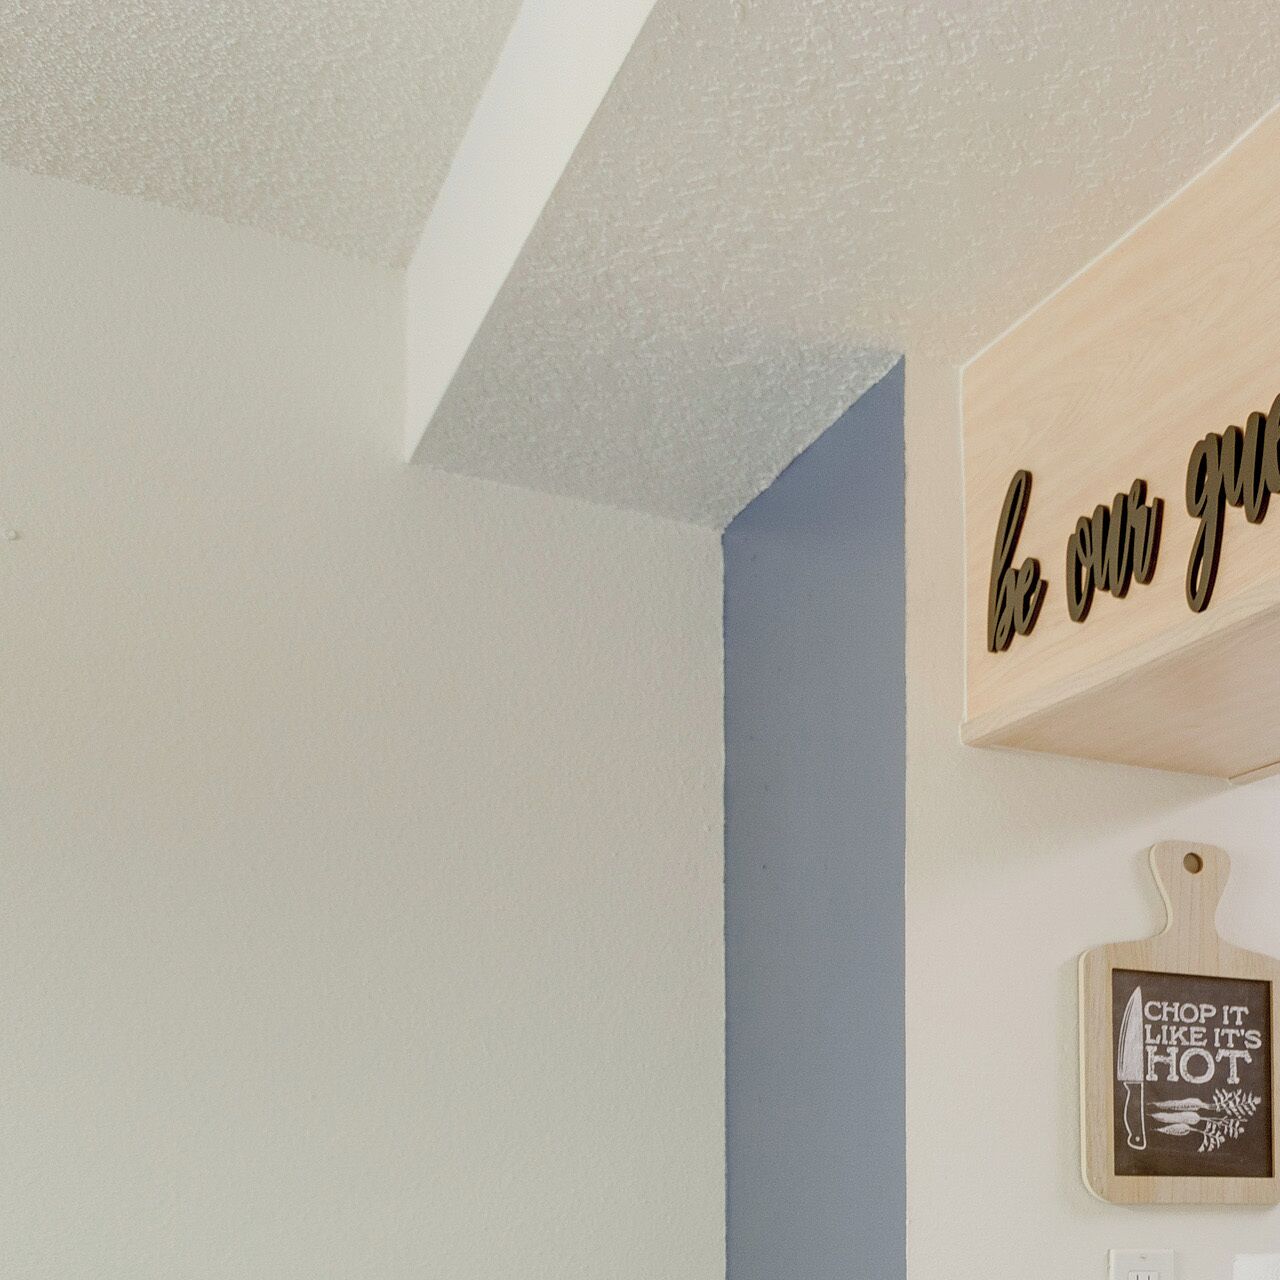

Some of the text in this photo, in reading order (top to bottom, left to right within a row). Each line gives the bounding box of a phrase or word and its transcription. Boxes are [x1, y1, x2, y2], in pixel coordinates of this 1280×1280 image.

[988, 470, 1048, 653] be
[1066, 478, 1164, 623] our
[1144, 1001, 1249, 1026] CHOP IT
[1144, 1024, 1262, 1050] LIKE IT'S
[1146, 1046, 1252, 1085] HOT
